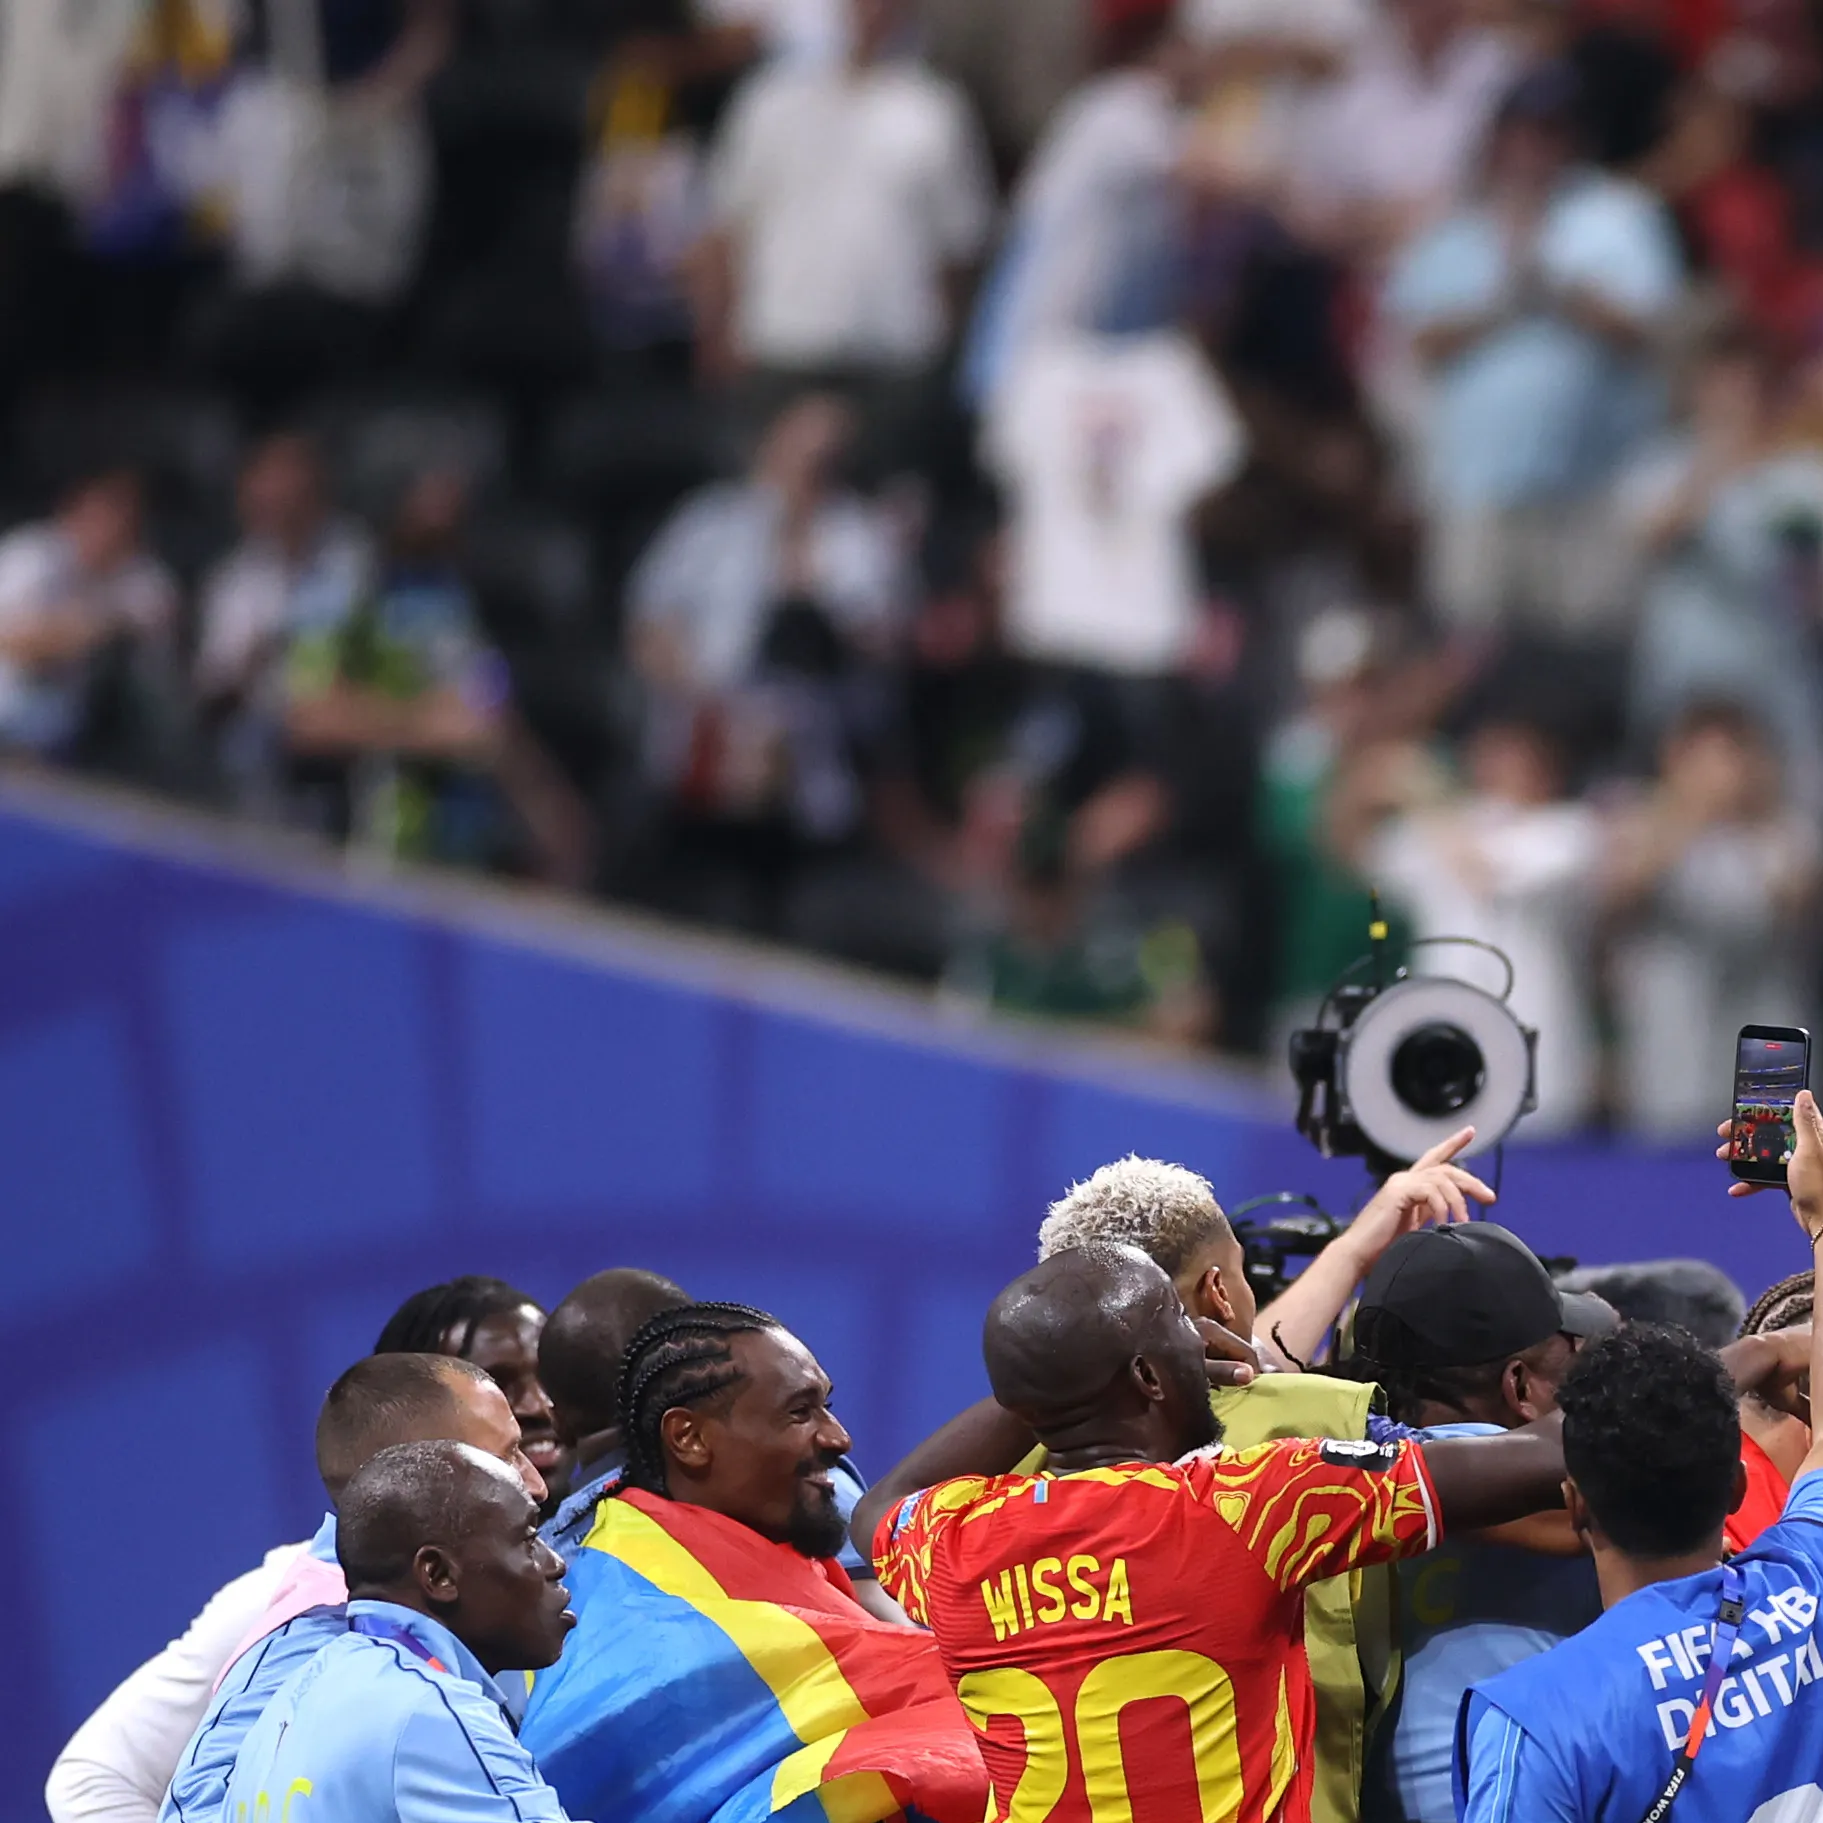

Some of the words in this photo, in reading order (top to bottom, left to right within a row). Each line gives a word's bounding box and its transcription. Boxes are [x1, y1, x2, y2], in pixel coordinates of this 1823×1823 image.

[980, 1554, 1134, 1642] WISSA
[1748, 1586, 1818, 1644] HB
[1664, 1767, 1685, 1798] FIFA
